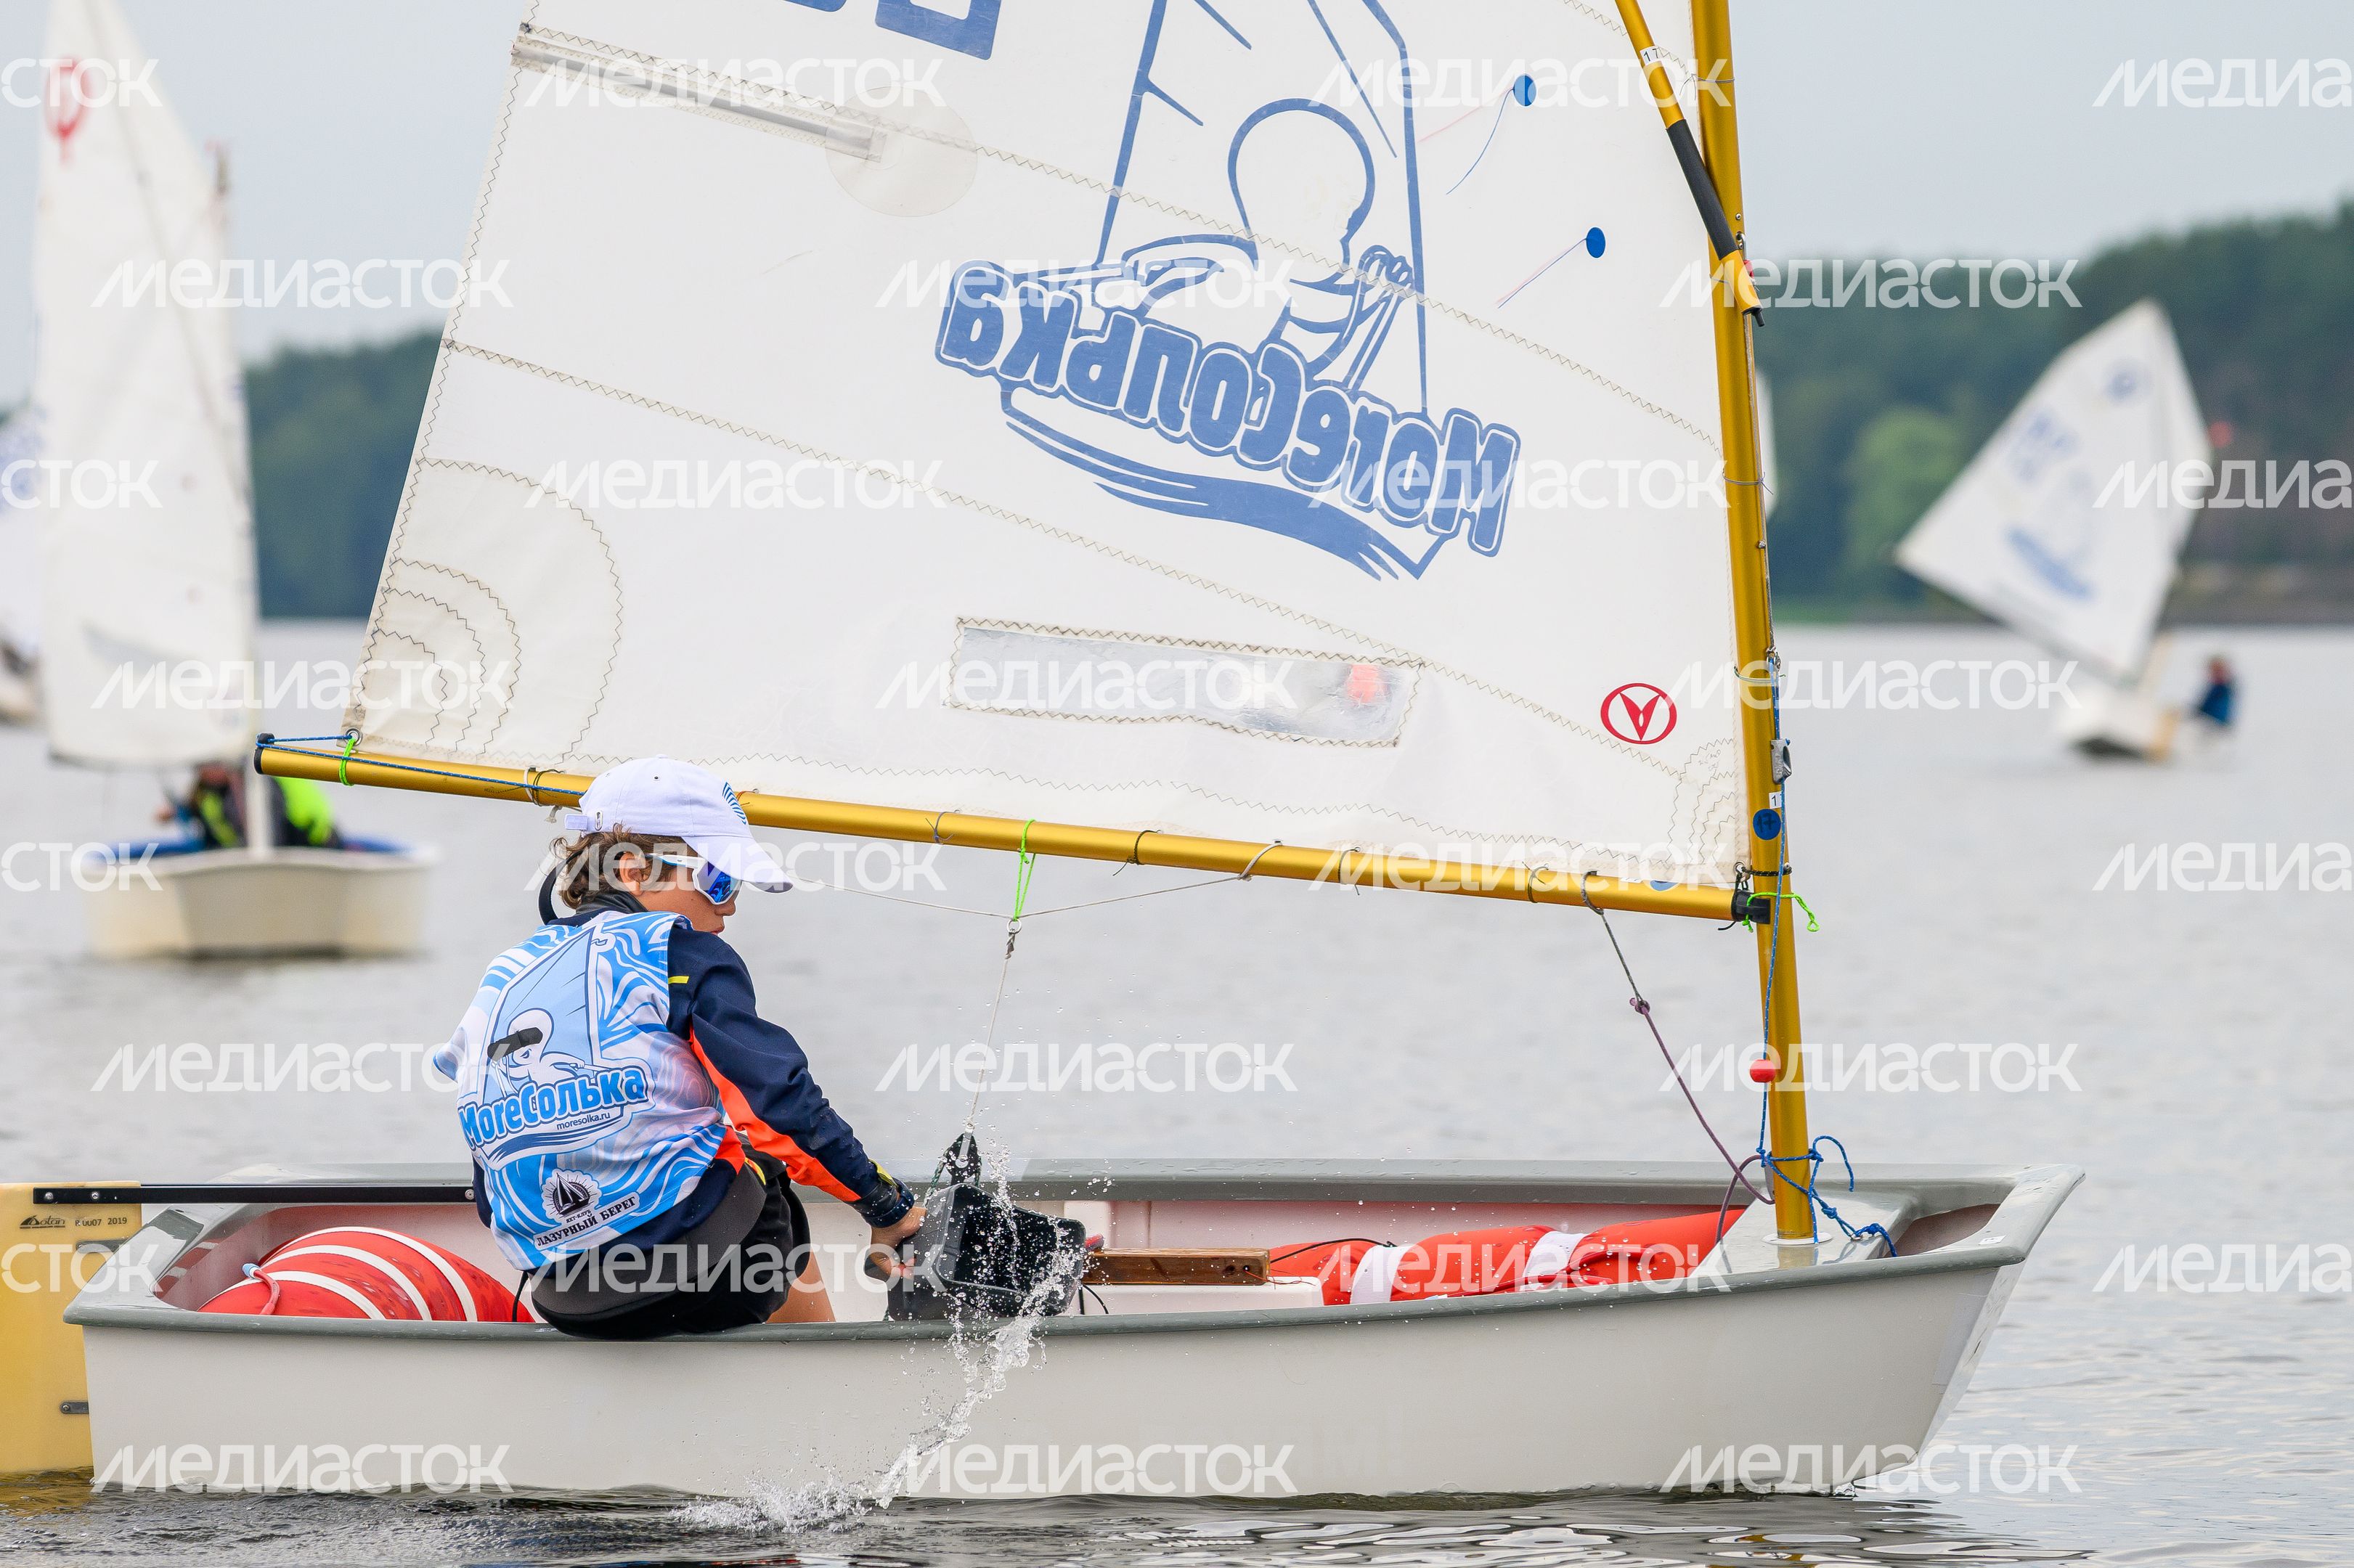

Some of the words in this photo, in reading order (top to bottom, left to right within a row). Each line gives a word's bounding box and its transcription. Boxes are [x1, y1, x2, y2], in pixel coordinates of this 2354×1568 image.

[1772, 793, 1782, 807] 1
[556, 1111, 611, 1130] moresolka.ru
[107, 1217, 127, 1225] 2019
[536, 1214, 599, 1246] ЛАЗУРНЫЙ
[599, 1196, 636, 1221] БЕРЕГ
[566, 1209, 592, 1224] ЯХТ-КЛУБ
